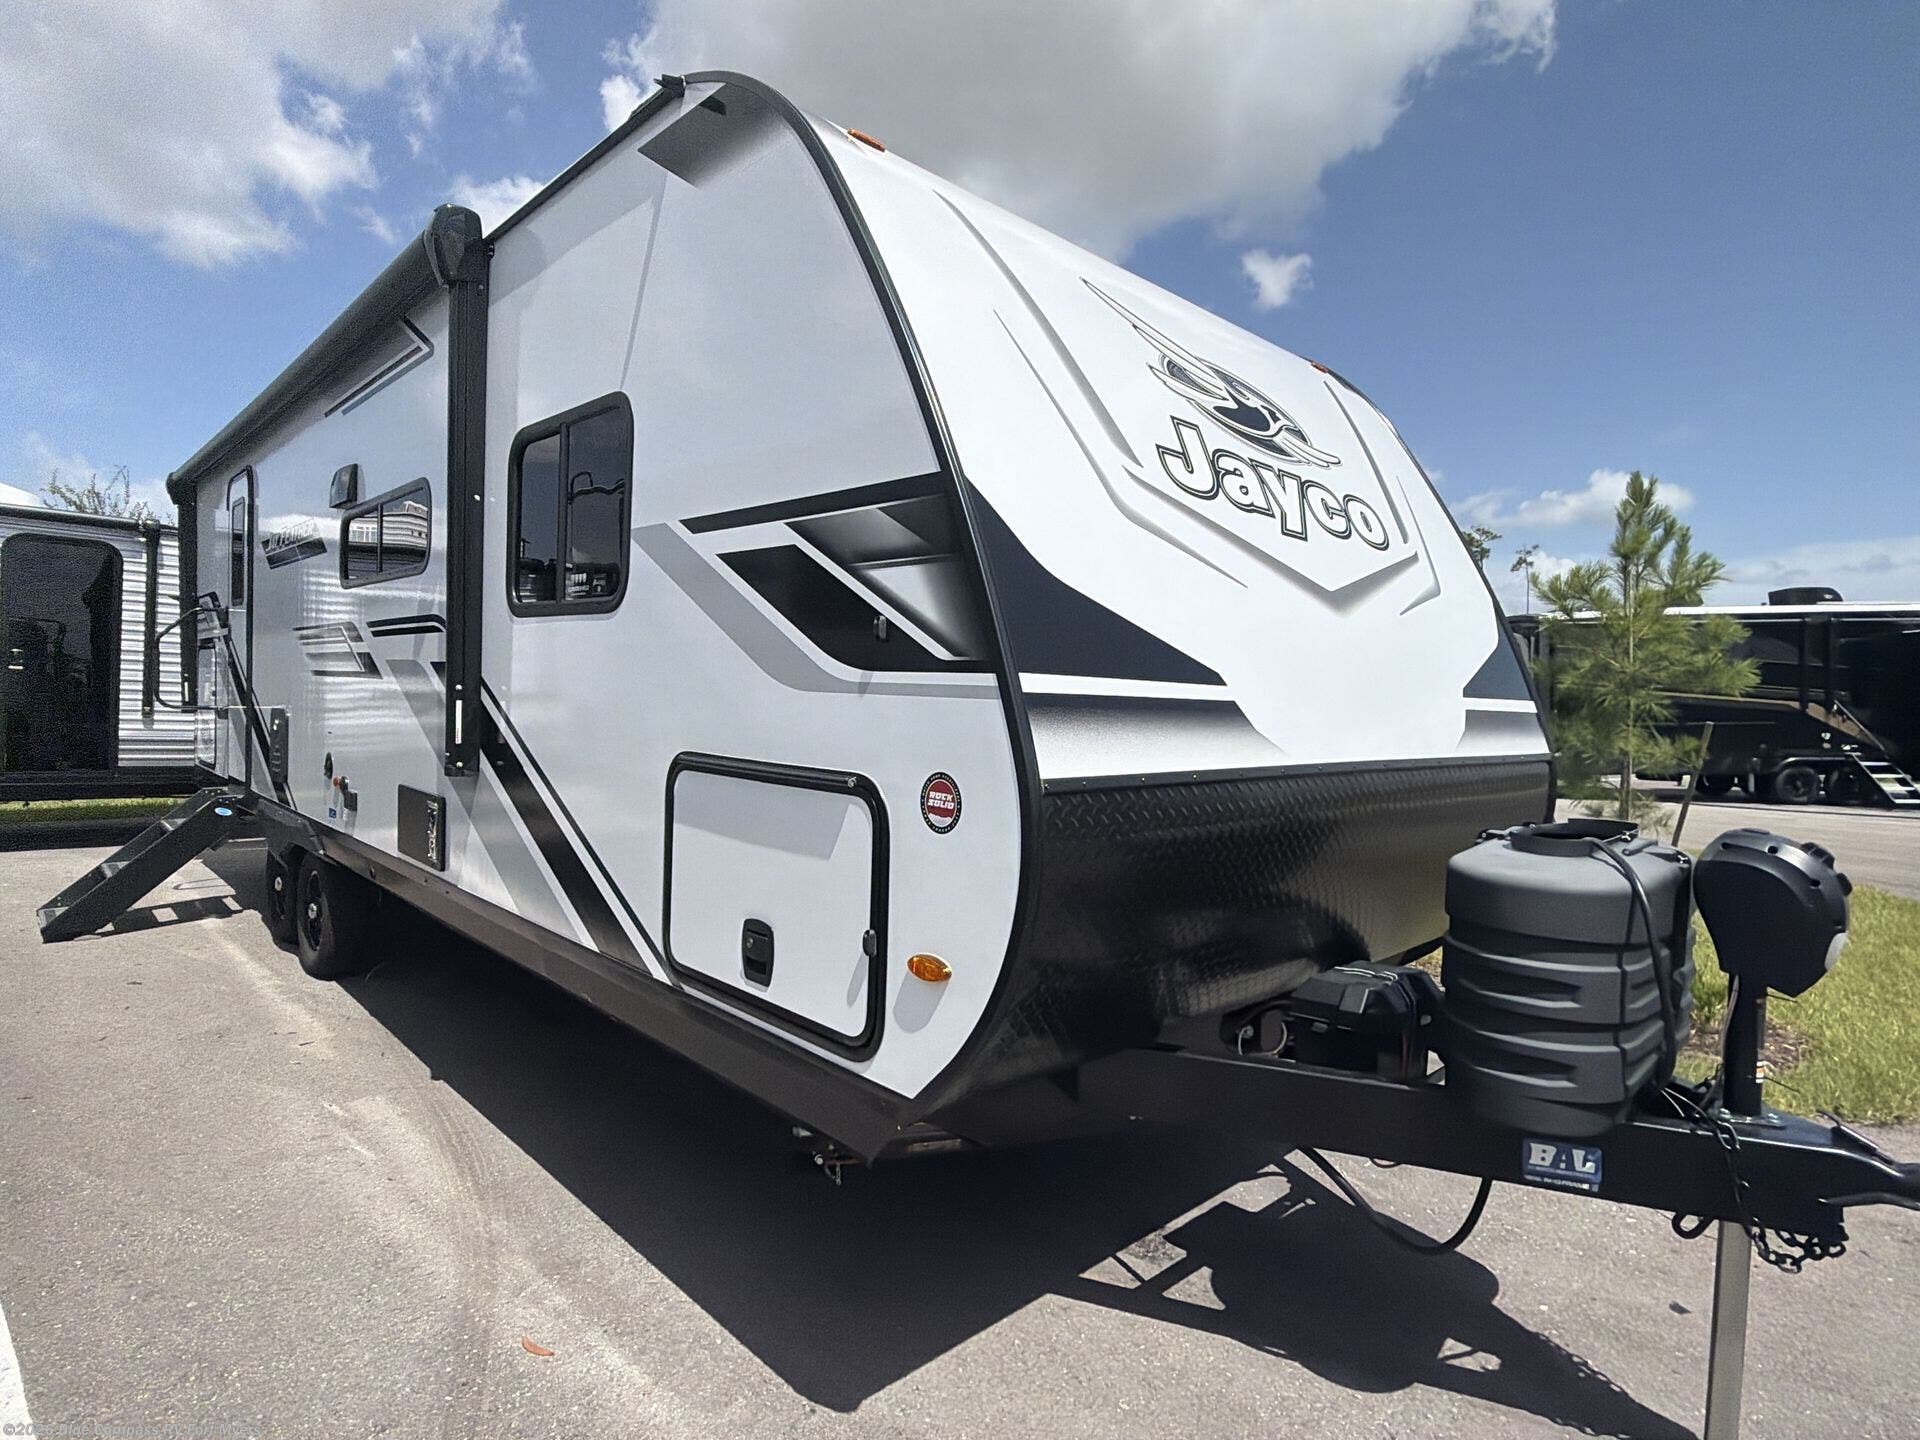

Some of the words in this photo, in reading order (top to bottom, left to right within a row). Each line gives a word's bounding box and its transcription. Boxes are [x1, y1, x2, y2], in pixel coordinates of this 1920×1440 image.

[1155, 415, 1390, 551] Jayco
[927, 798, 955, 810] SOLID
[928, 791, 954, 801] ROCK
[1528, 1142, 1596, 1174] BAL
